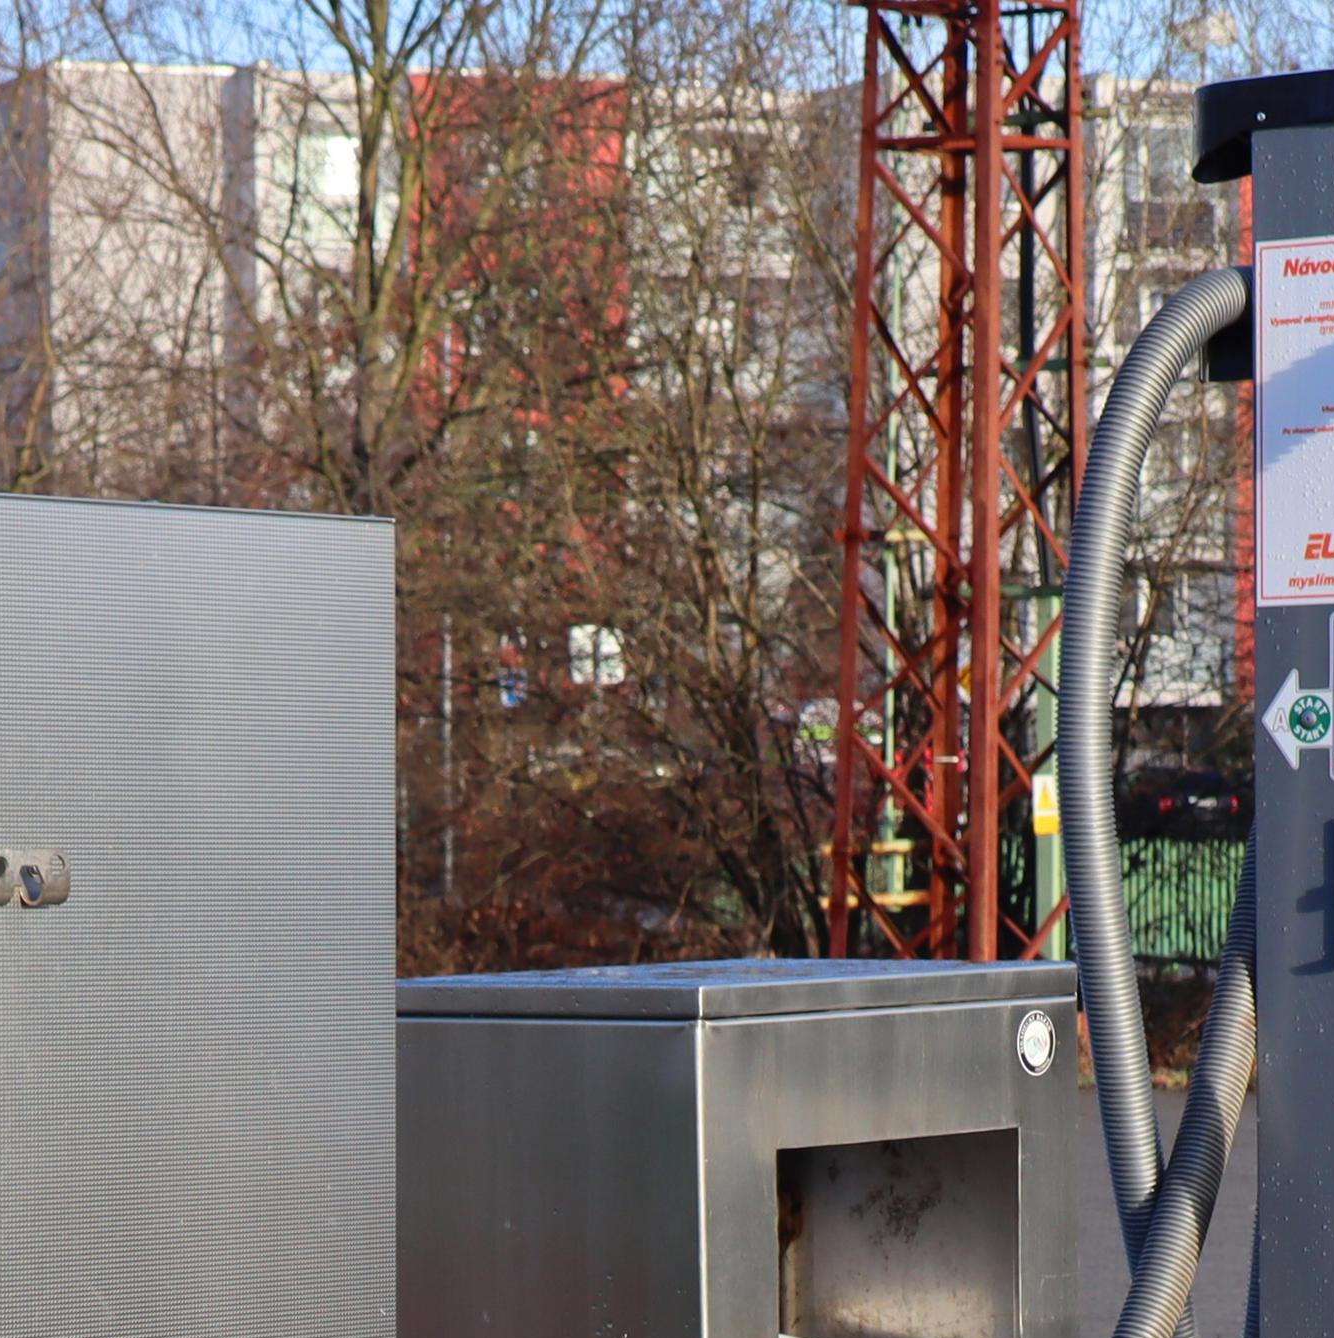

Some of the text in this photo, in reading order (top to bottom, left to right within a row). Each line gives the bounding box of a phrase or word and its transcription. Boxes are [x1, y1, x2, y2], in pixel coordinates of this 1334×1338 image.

[1293, 697, 1328, 716] START
[1272, 707, 1290, 733] A
[1292, 725, 1326, 742] START
